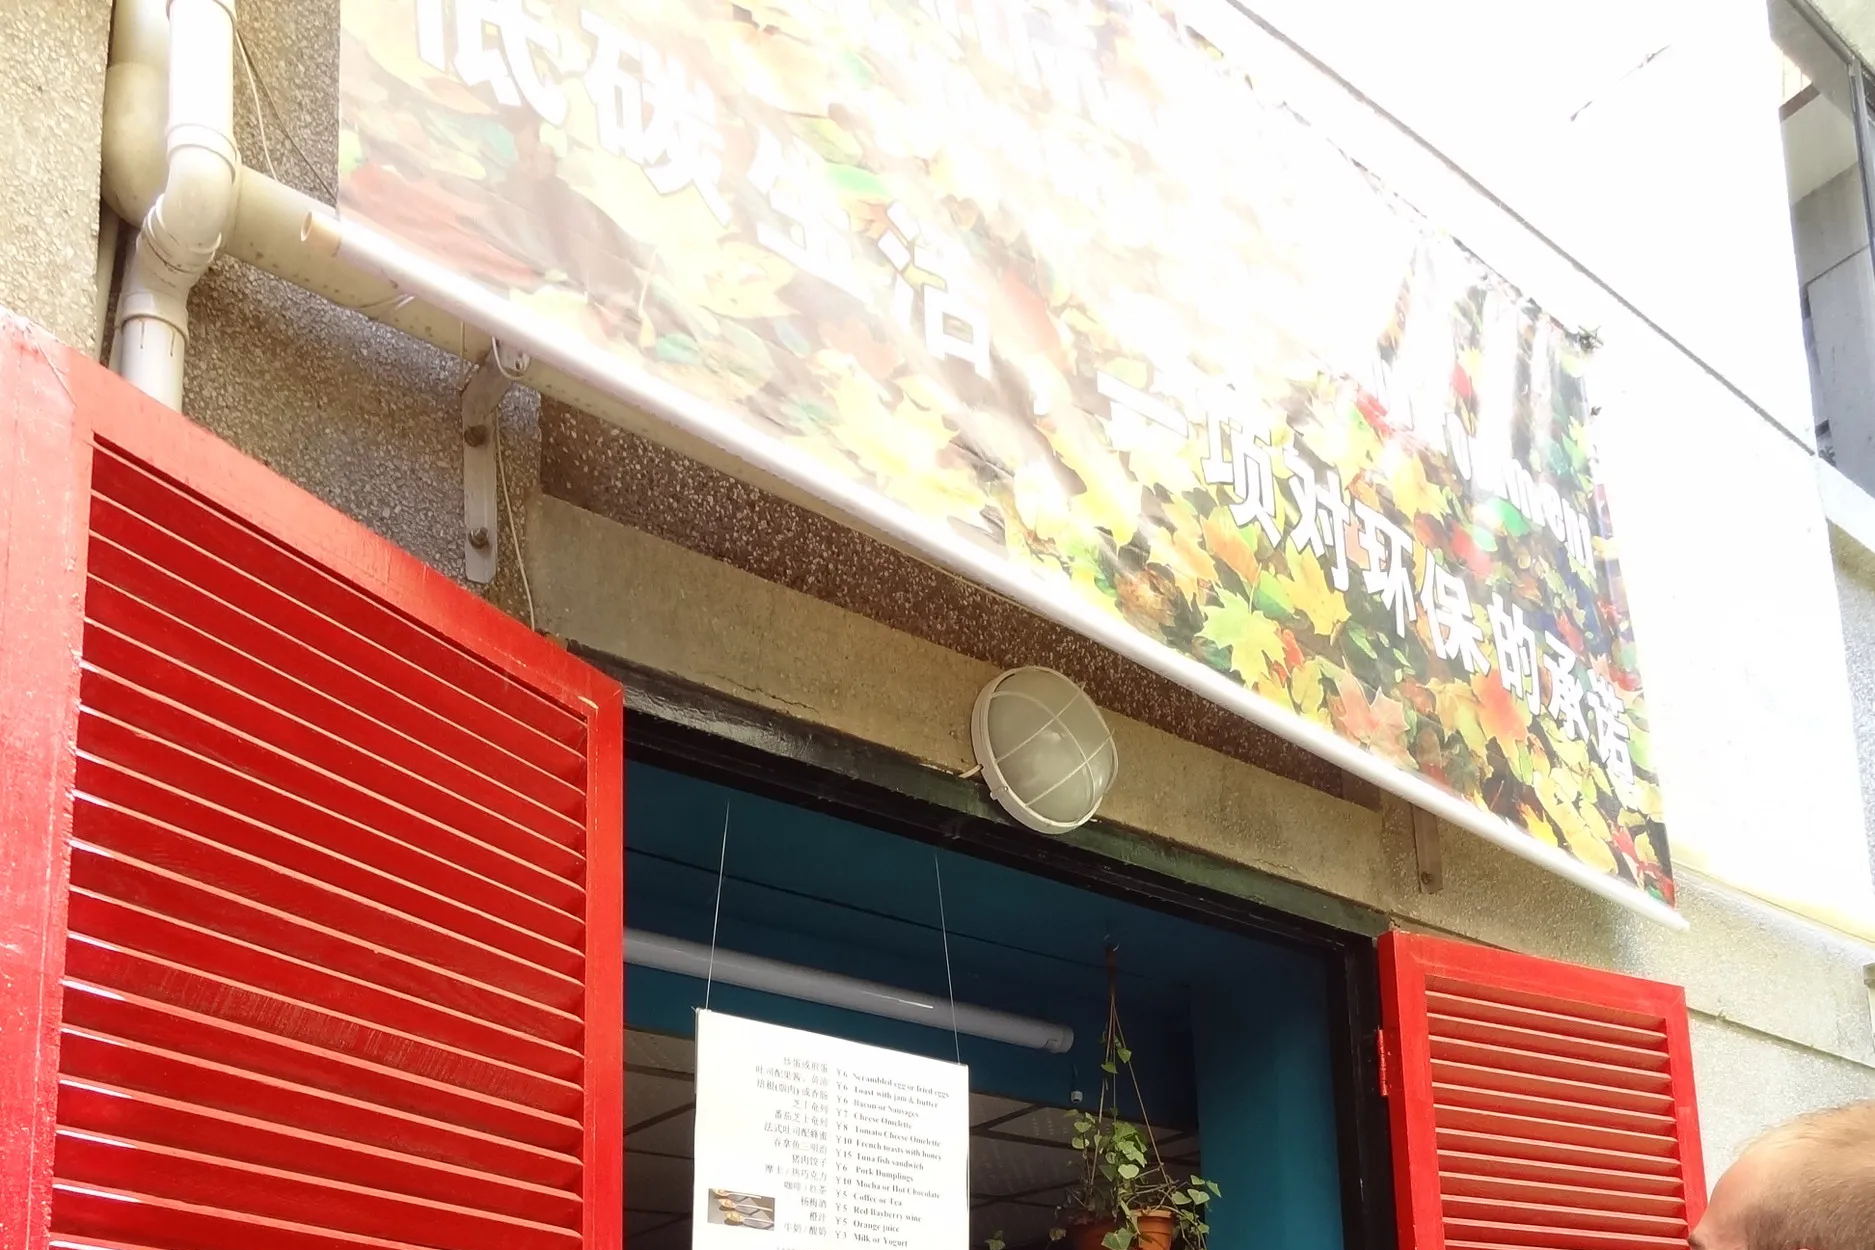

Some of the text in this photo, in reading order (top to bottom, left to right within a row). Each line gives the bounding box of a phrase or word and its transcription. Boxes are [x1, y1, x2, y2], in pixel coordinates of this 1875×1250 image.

[1095, 369, 1636, 785] 一项对环保的承诺
[853, 1099, 877, 1109] Bacon
[854, 1085, 874, 1096] Toast
[876, 1089, 892, 1099] with
[893, 1093, 907, 1102] jam
[916, 1096, 938, 1109] butter
[853, 1112, 879, 1123] Cheese
[855, 1125, 882, 1137] Tomato
[884, 1131, 909, 1142] Cheese
[909, 1135, 941, 1148] Omelette
[856, 1138, 882, 1151] French
[905, 1147, 921, 1157] with
[856, 1152, 875, 1163] Tuna
[877, 1155, 890, 1165] fish
[891, 1159, 924, 1171] sandwich
[855, 1165, 874, 1176] Pork
[875, 1169, 914, 1182] Dumplings
[855, 1179, 881, 1190] Mocha
[892, 1184, 906, 1193] Hot
[906, 1187, 941, 1199] Chocolate
[853, 1193, 878, 1203] Coffee
[878, 1197, 887, 1205] or
[889, 1198, 902, 1206] Tea
[853, 1206, 868, 1215] Red
[905, 1213, 922, 1223] wine
[853, 1219, 881, 1231] Orange
[882, 1224, 900, 1233] juice
[853, 1233, 870, 1243] Milk
[872, 1236, 880, 1244] or
[883, 1237, 908, 1247] Yogurt
